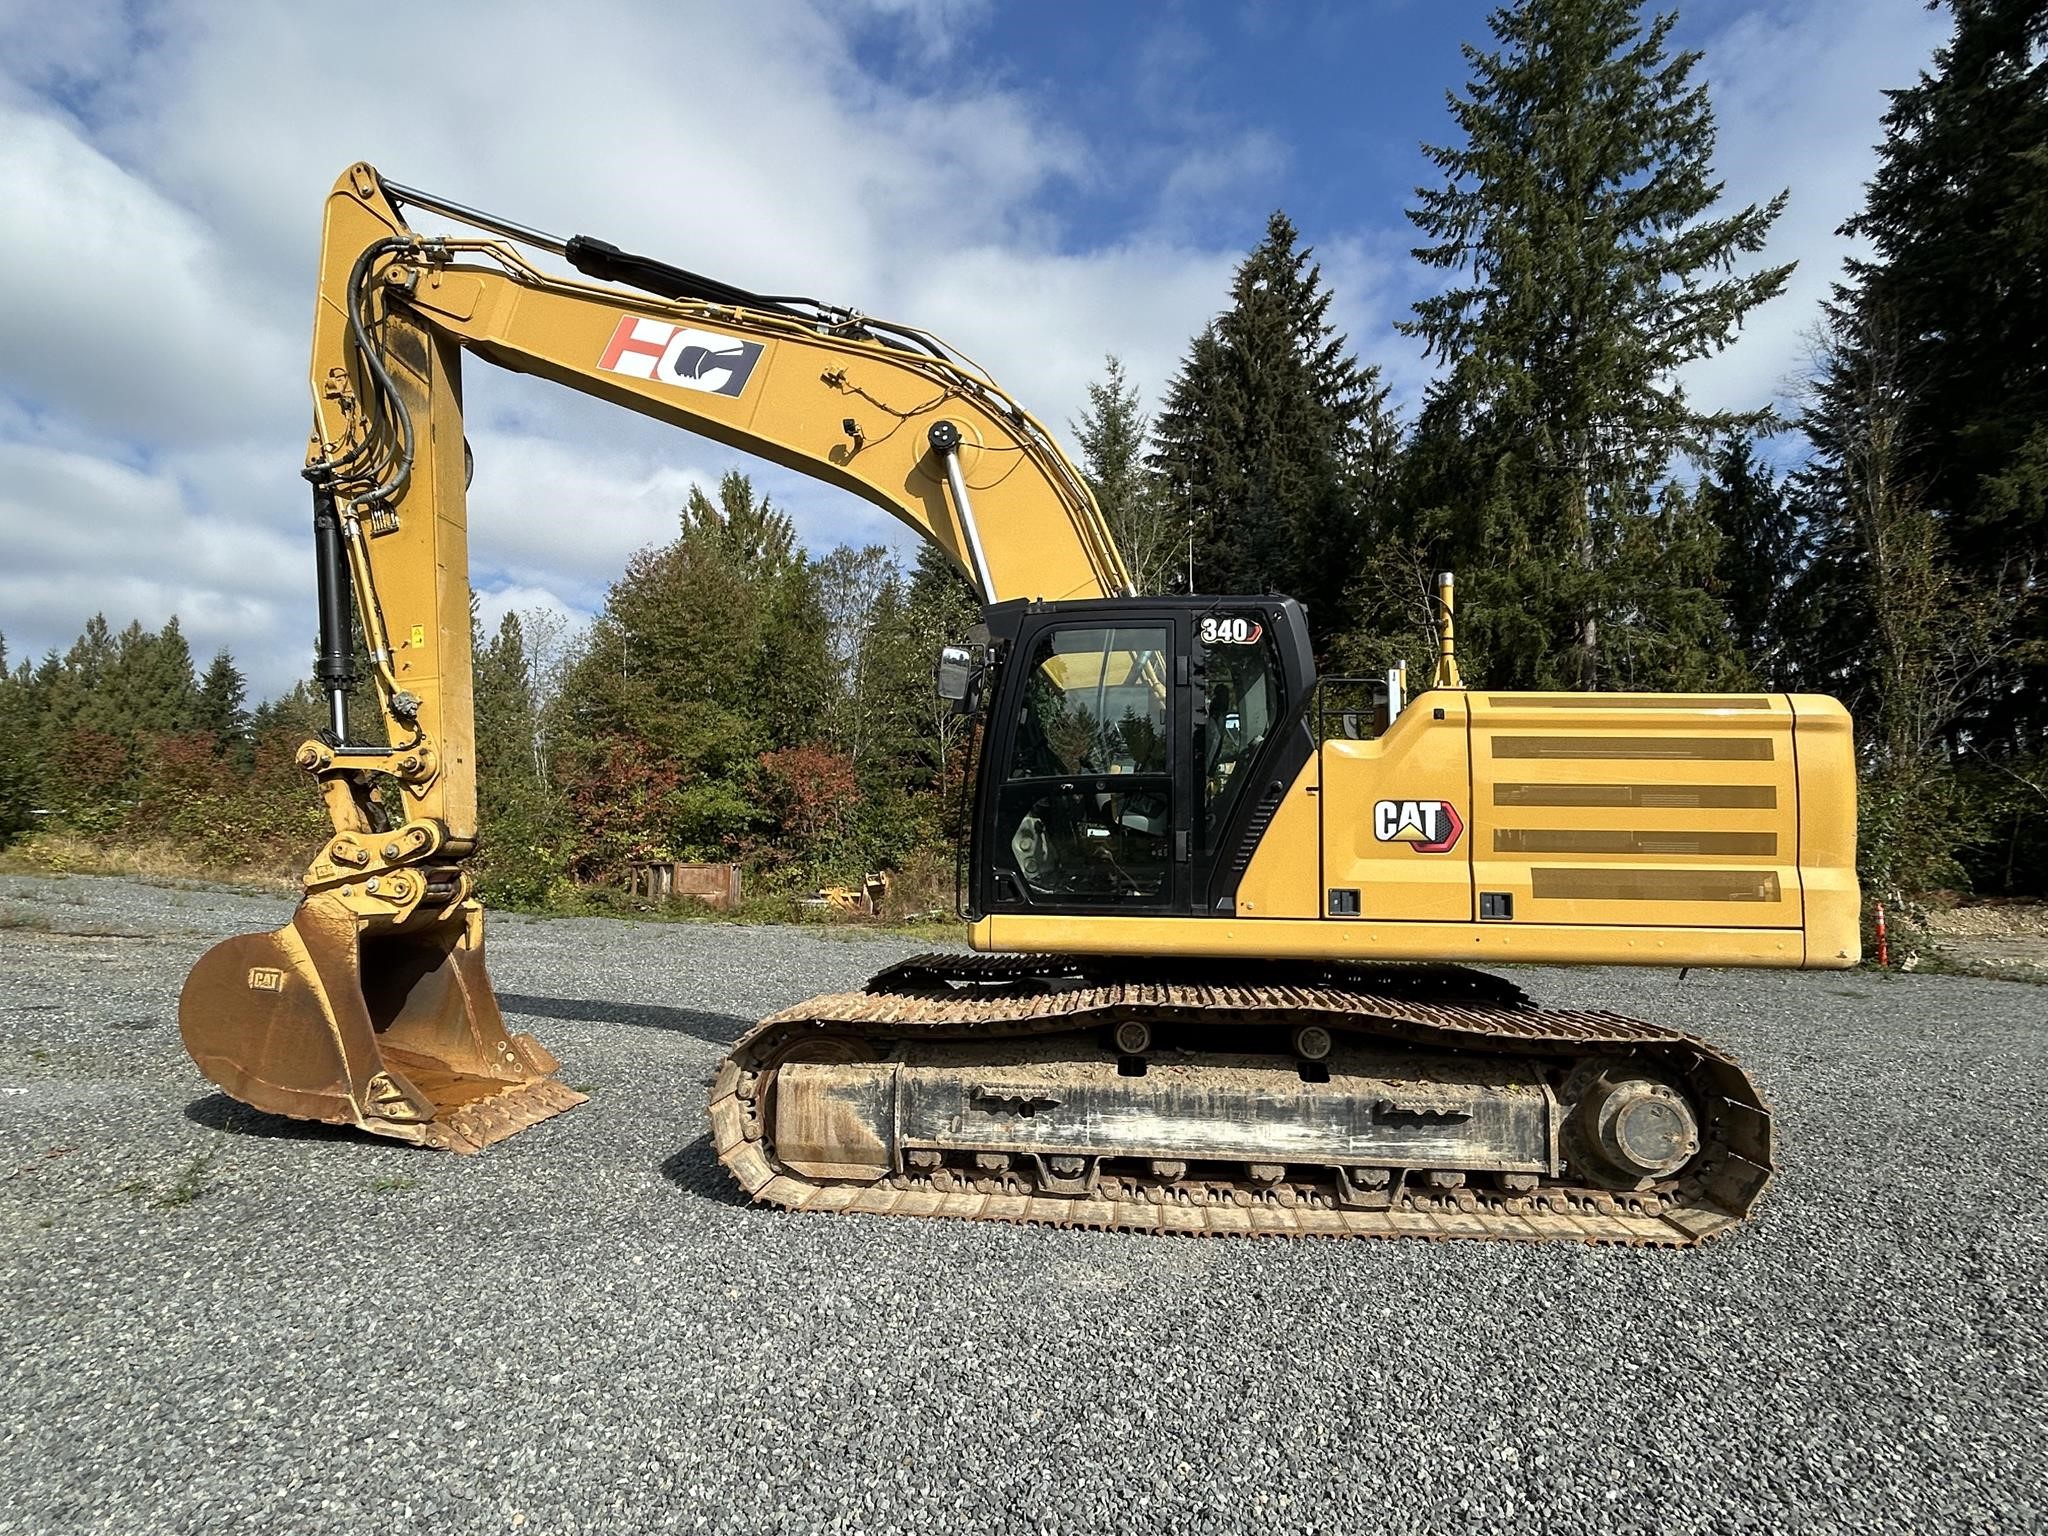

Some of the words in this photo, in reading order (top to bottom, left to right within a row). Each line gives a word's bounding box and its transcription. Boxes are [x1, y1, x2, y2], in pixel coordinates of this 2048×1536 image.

[1203, 618, 1247, 641] 340
[1375, 801, 1441, 841] CAT
[254, 972, 278, 989] CAT
